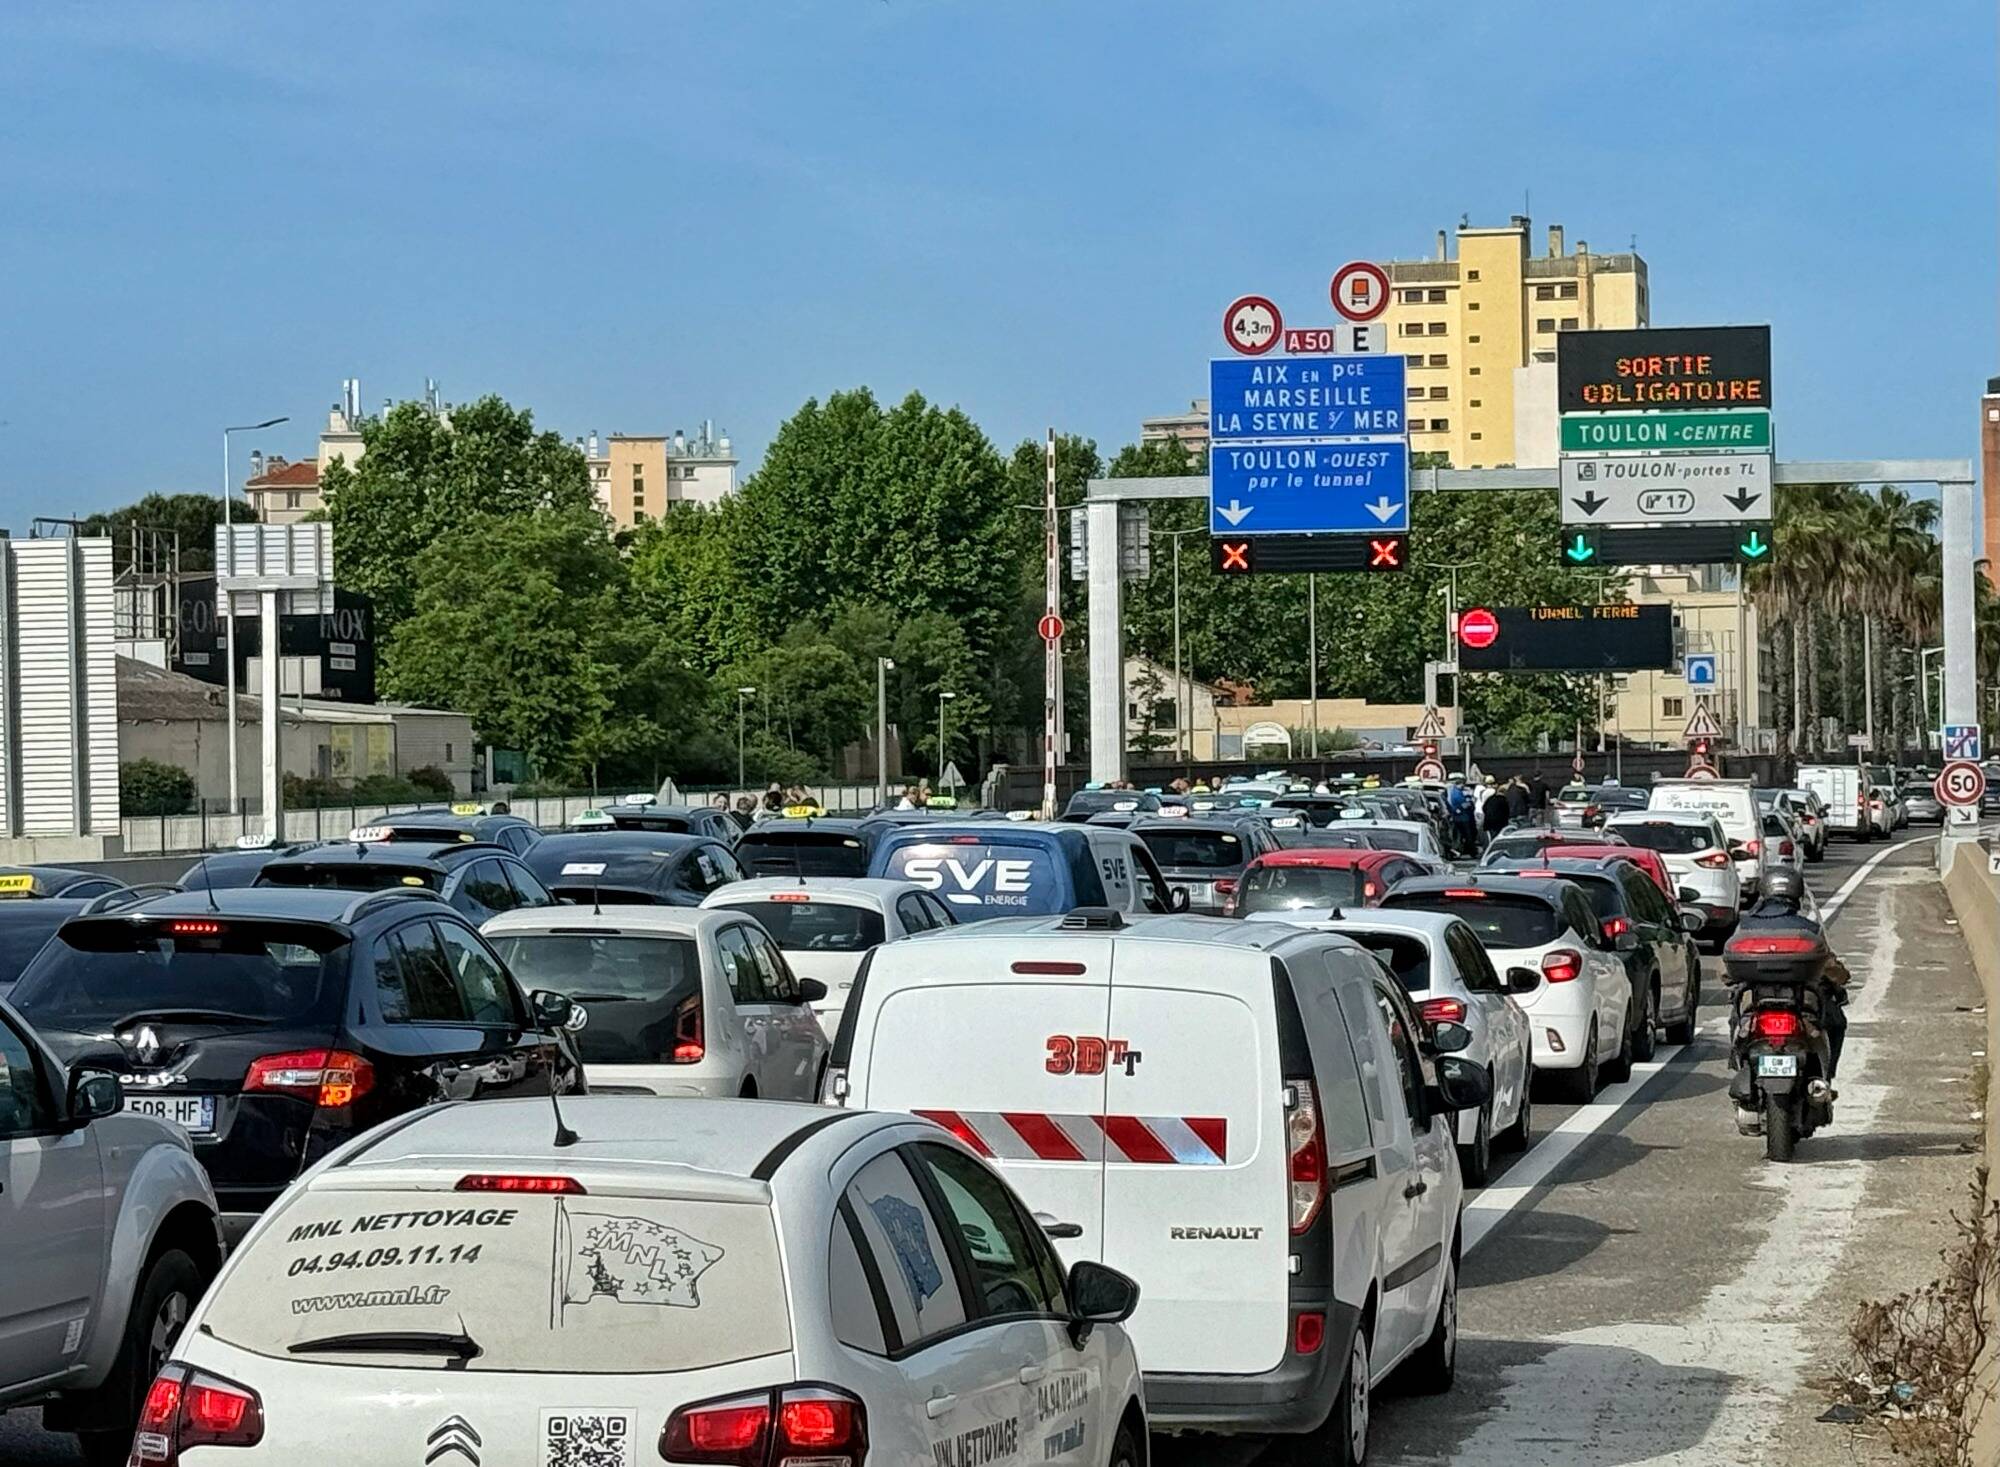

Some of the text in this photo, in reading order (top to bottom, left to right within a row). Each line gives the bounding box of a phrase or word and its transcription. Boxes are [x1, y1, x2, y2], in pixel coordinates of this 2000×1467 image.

[1234, 319, 1271, 336] 4,3m
[1353, 327, 1369, 352] E
[1251, 366, 1288, 385] AIX
[1301, 370, 1319, 383] EN
[1615, 355, 1712, 377] SORTIE
[1245, 387, 1371, 407] MARSEILLE
[1582, 379, 1762, 404] OBLIGATOIRE
[1218, 414, 1241, 432] LA
[1252, 412, 1319, 431] SEYNE
[1354, 410, 1398, 429] MER
[1739, 463, 1756, 476] TL
[1248, 471, 1372, 492] par le tunnel
[1666, 494, 1687, 509] 17
[1530, 606, 1639, 620] TUNNEL FERME
[1950, 775, 1975, 793] 50
[904, 858, 1034, 892] SVE
[1102, 858, 1127, 880] SVE
[287, 1209, 518, 1243] MNL NETTOYAGE
[1170, 1226, 1263, 1240] RENAULT
[287, 1244, 483, 1277] 04.94.09.11.14
[597, 1230, 669, 1281] MNL
[291, 1285, 451, 1315] www.mnl.fr
[957, 1416, 1018, 1467] NETTOYAGE
